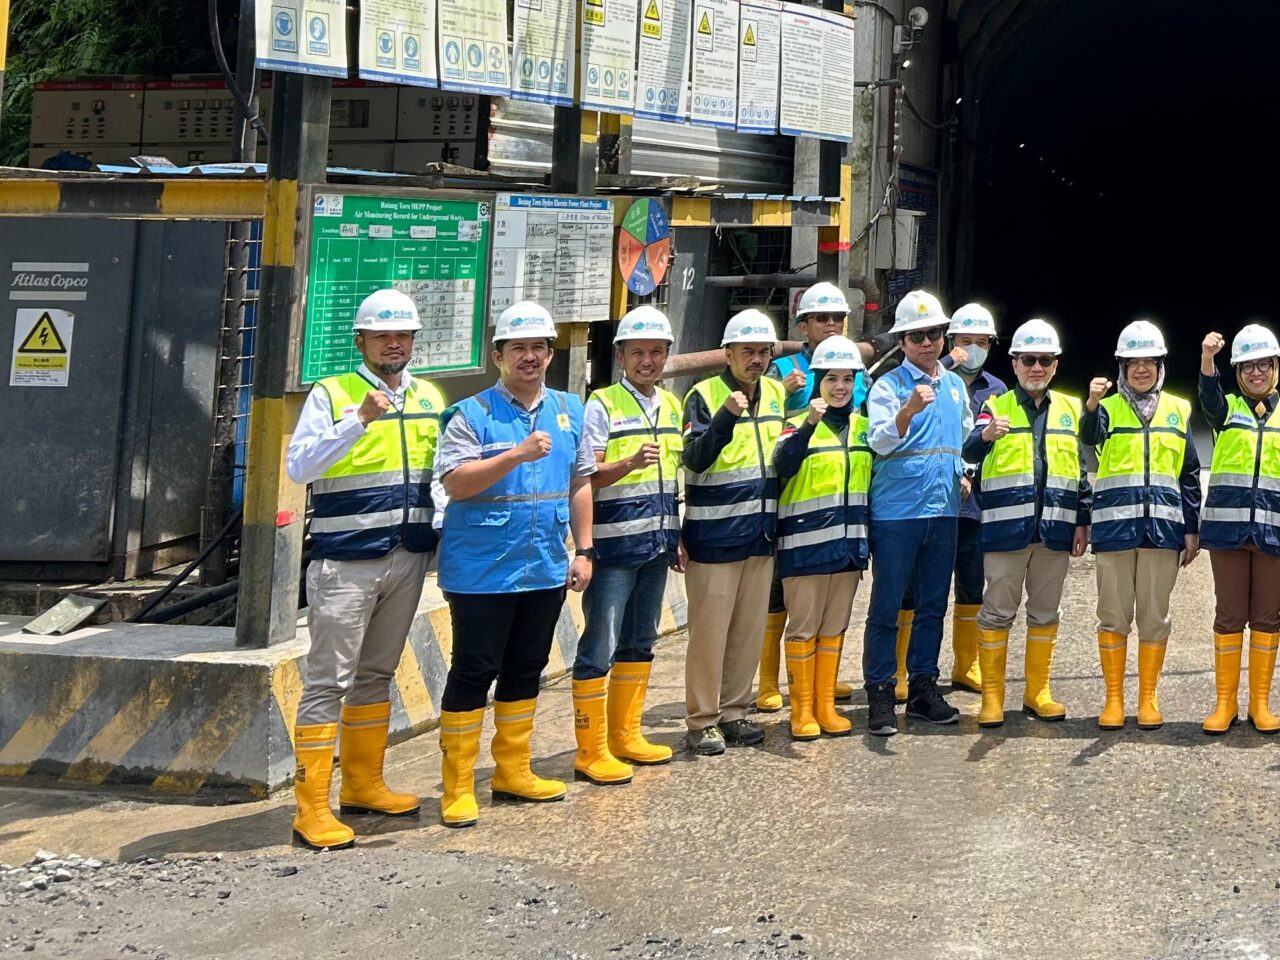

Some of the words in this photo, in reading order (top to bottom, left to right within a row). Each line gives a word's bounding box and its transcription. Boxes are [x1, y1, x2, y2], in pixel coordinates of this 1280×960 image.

[354, 210, 363, 218] Air
[10, 274, 49, 287] Atlas
[51, 274, 88, 289] Copco
[682, 267, 695, 291] 12
